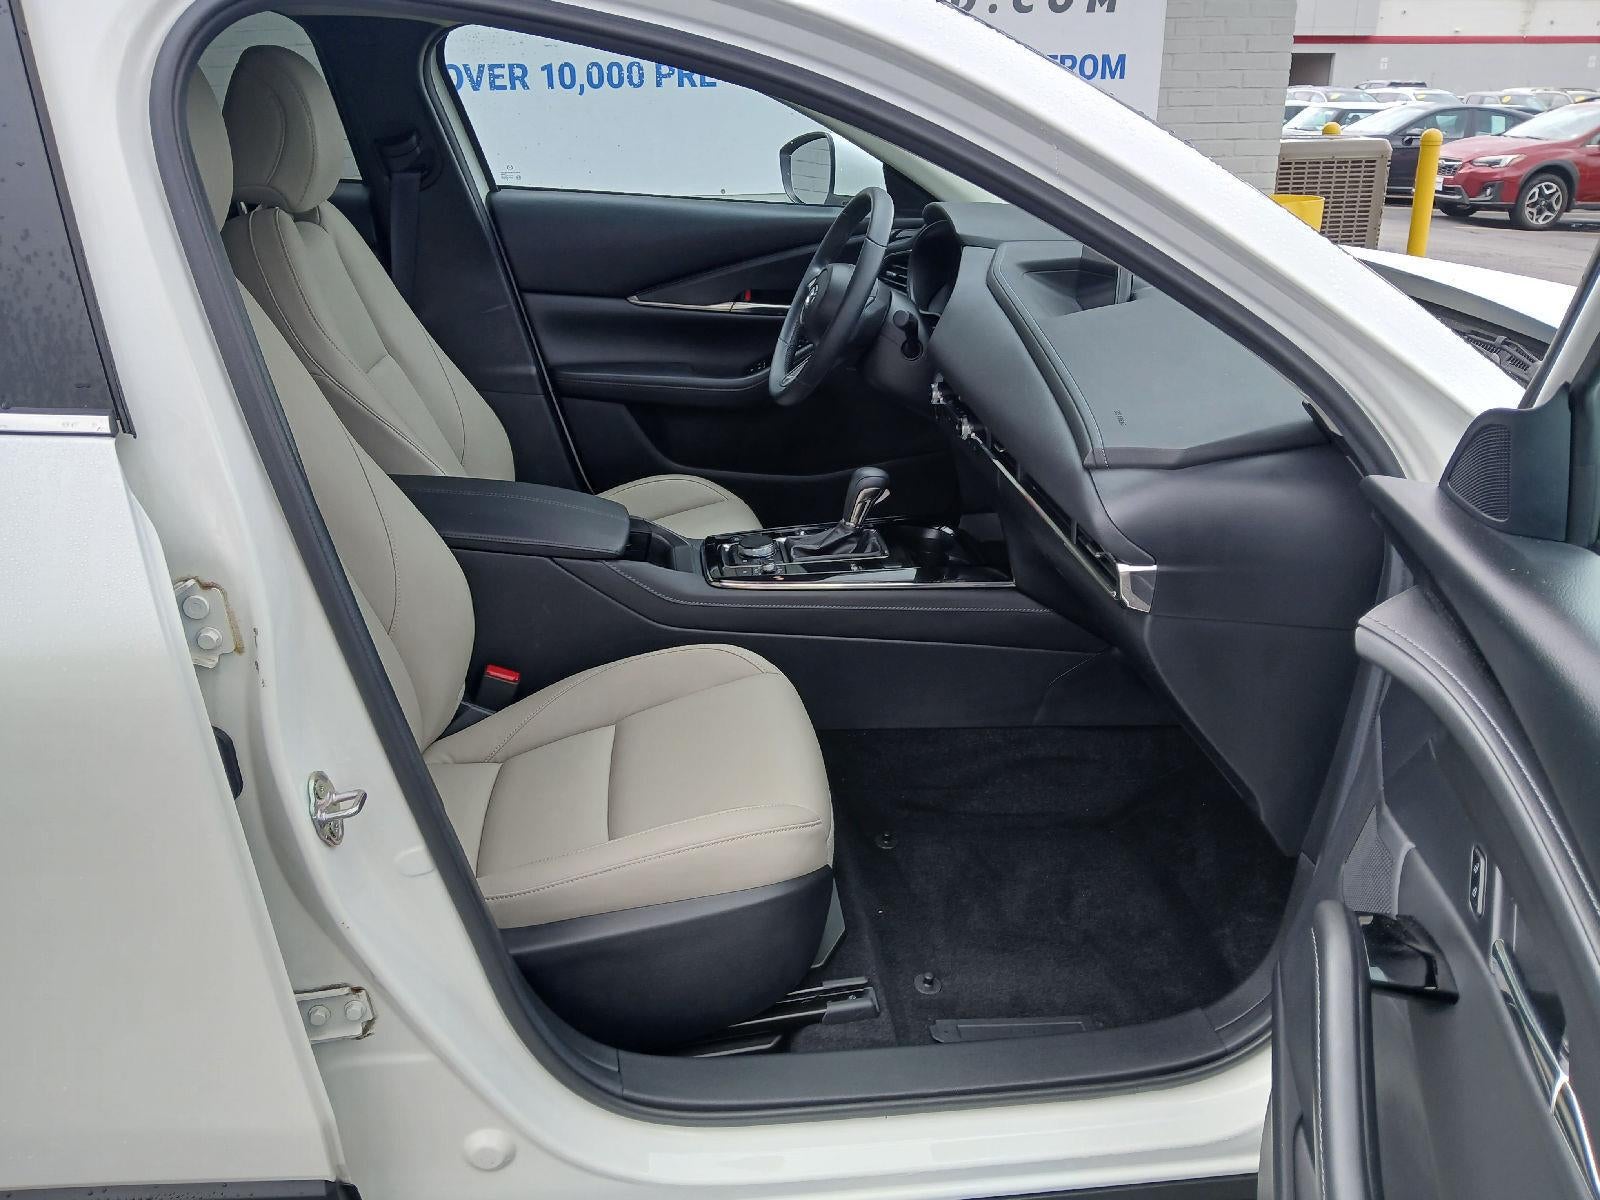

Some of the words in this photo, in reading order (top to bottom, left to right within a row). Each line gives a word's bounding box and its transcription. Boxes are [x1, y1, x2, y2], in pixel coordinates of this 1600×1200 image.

[446, 63, 530, 91] OVER
[540, 61, 645, 96] 10,000
[1046, 53, 1127, 81] ROM
